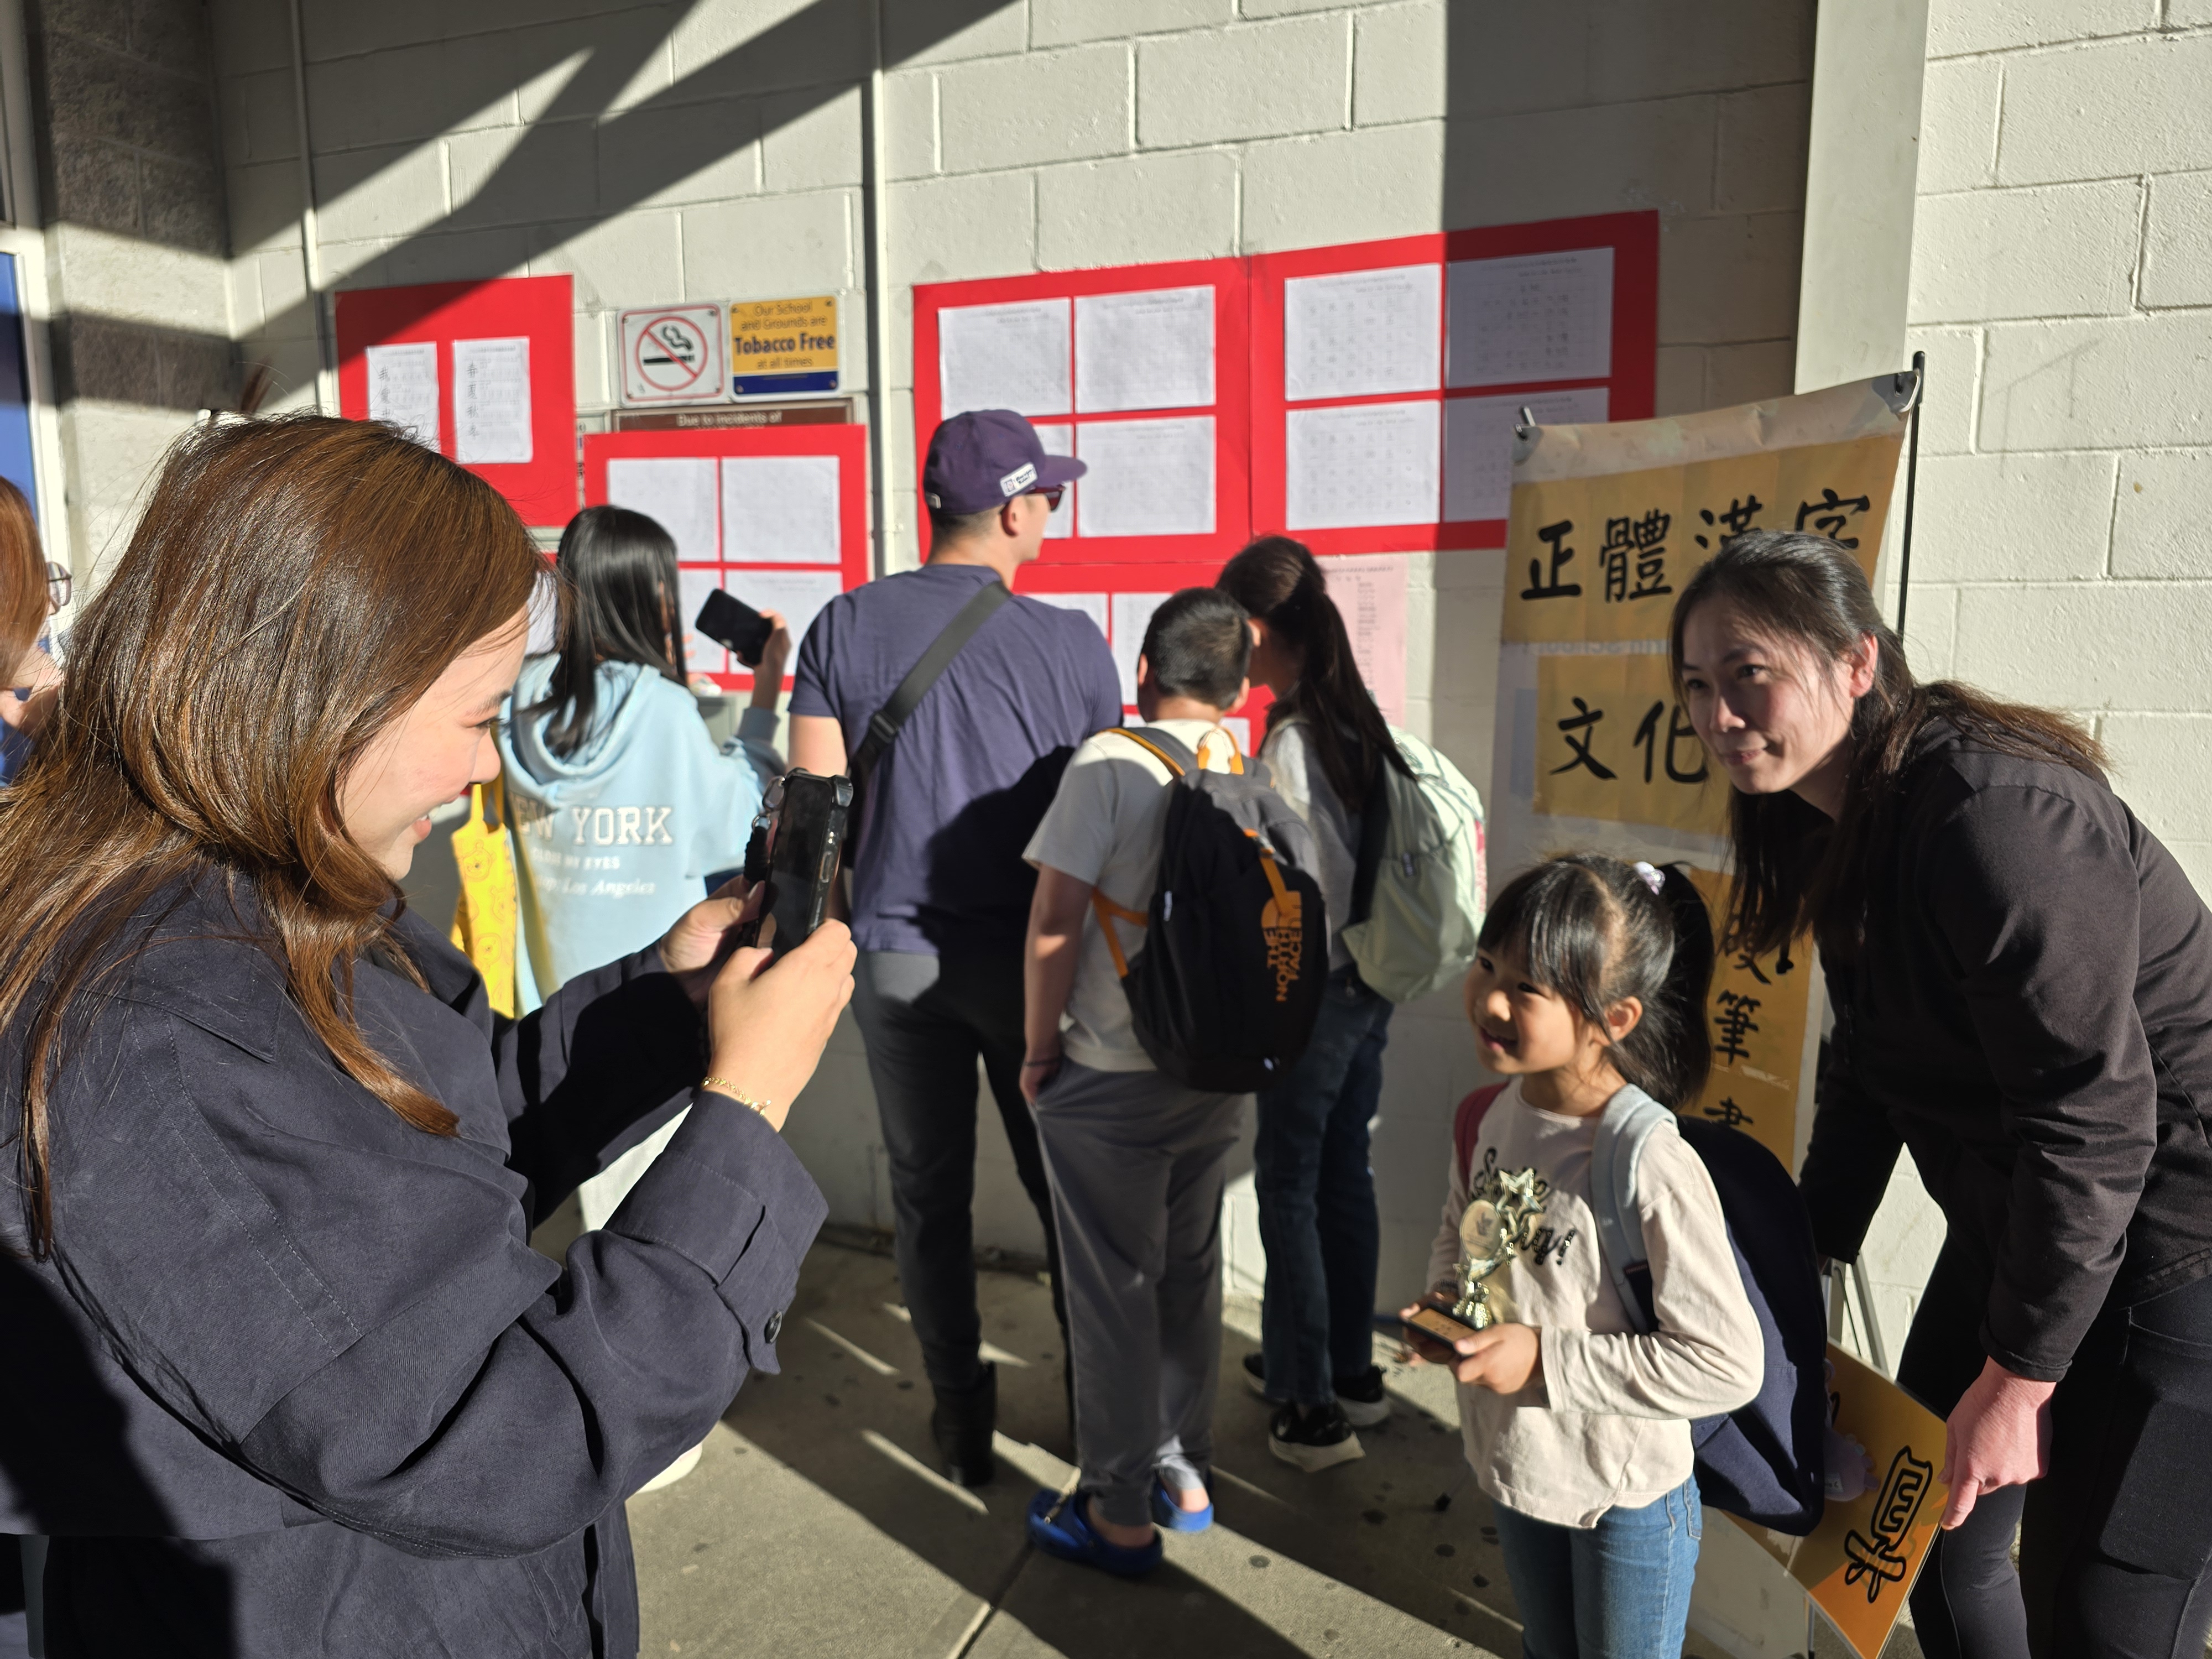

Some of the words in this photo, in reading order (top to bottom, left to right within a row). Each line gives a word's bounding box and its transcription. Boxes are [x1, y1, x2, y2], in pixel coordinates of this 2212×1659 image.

[754, 303, 774, 316] Our
[776, 301, 812, 315] School
[741, 320, 761, 331] and
[763, 317, 807, 330] Grounds
[810, 316, 827, 326] are
[734, 336, 795, 355] Tobacco
[800, 332, 835, 351] Free
[757, 359, 767, 369] at
[770, 357, 781, 367] all
[784, 356, 813, 367] times
[676, 413, 700, 426] Due
[702, 415, 715, 426] to
[769, 410, 782, 424] of
[1550, 696, 1709, 784] 文化
[510, 793, 555, 839] EW
[571, 806, 673, 845] YORK
